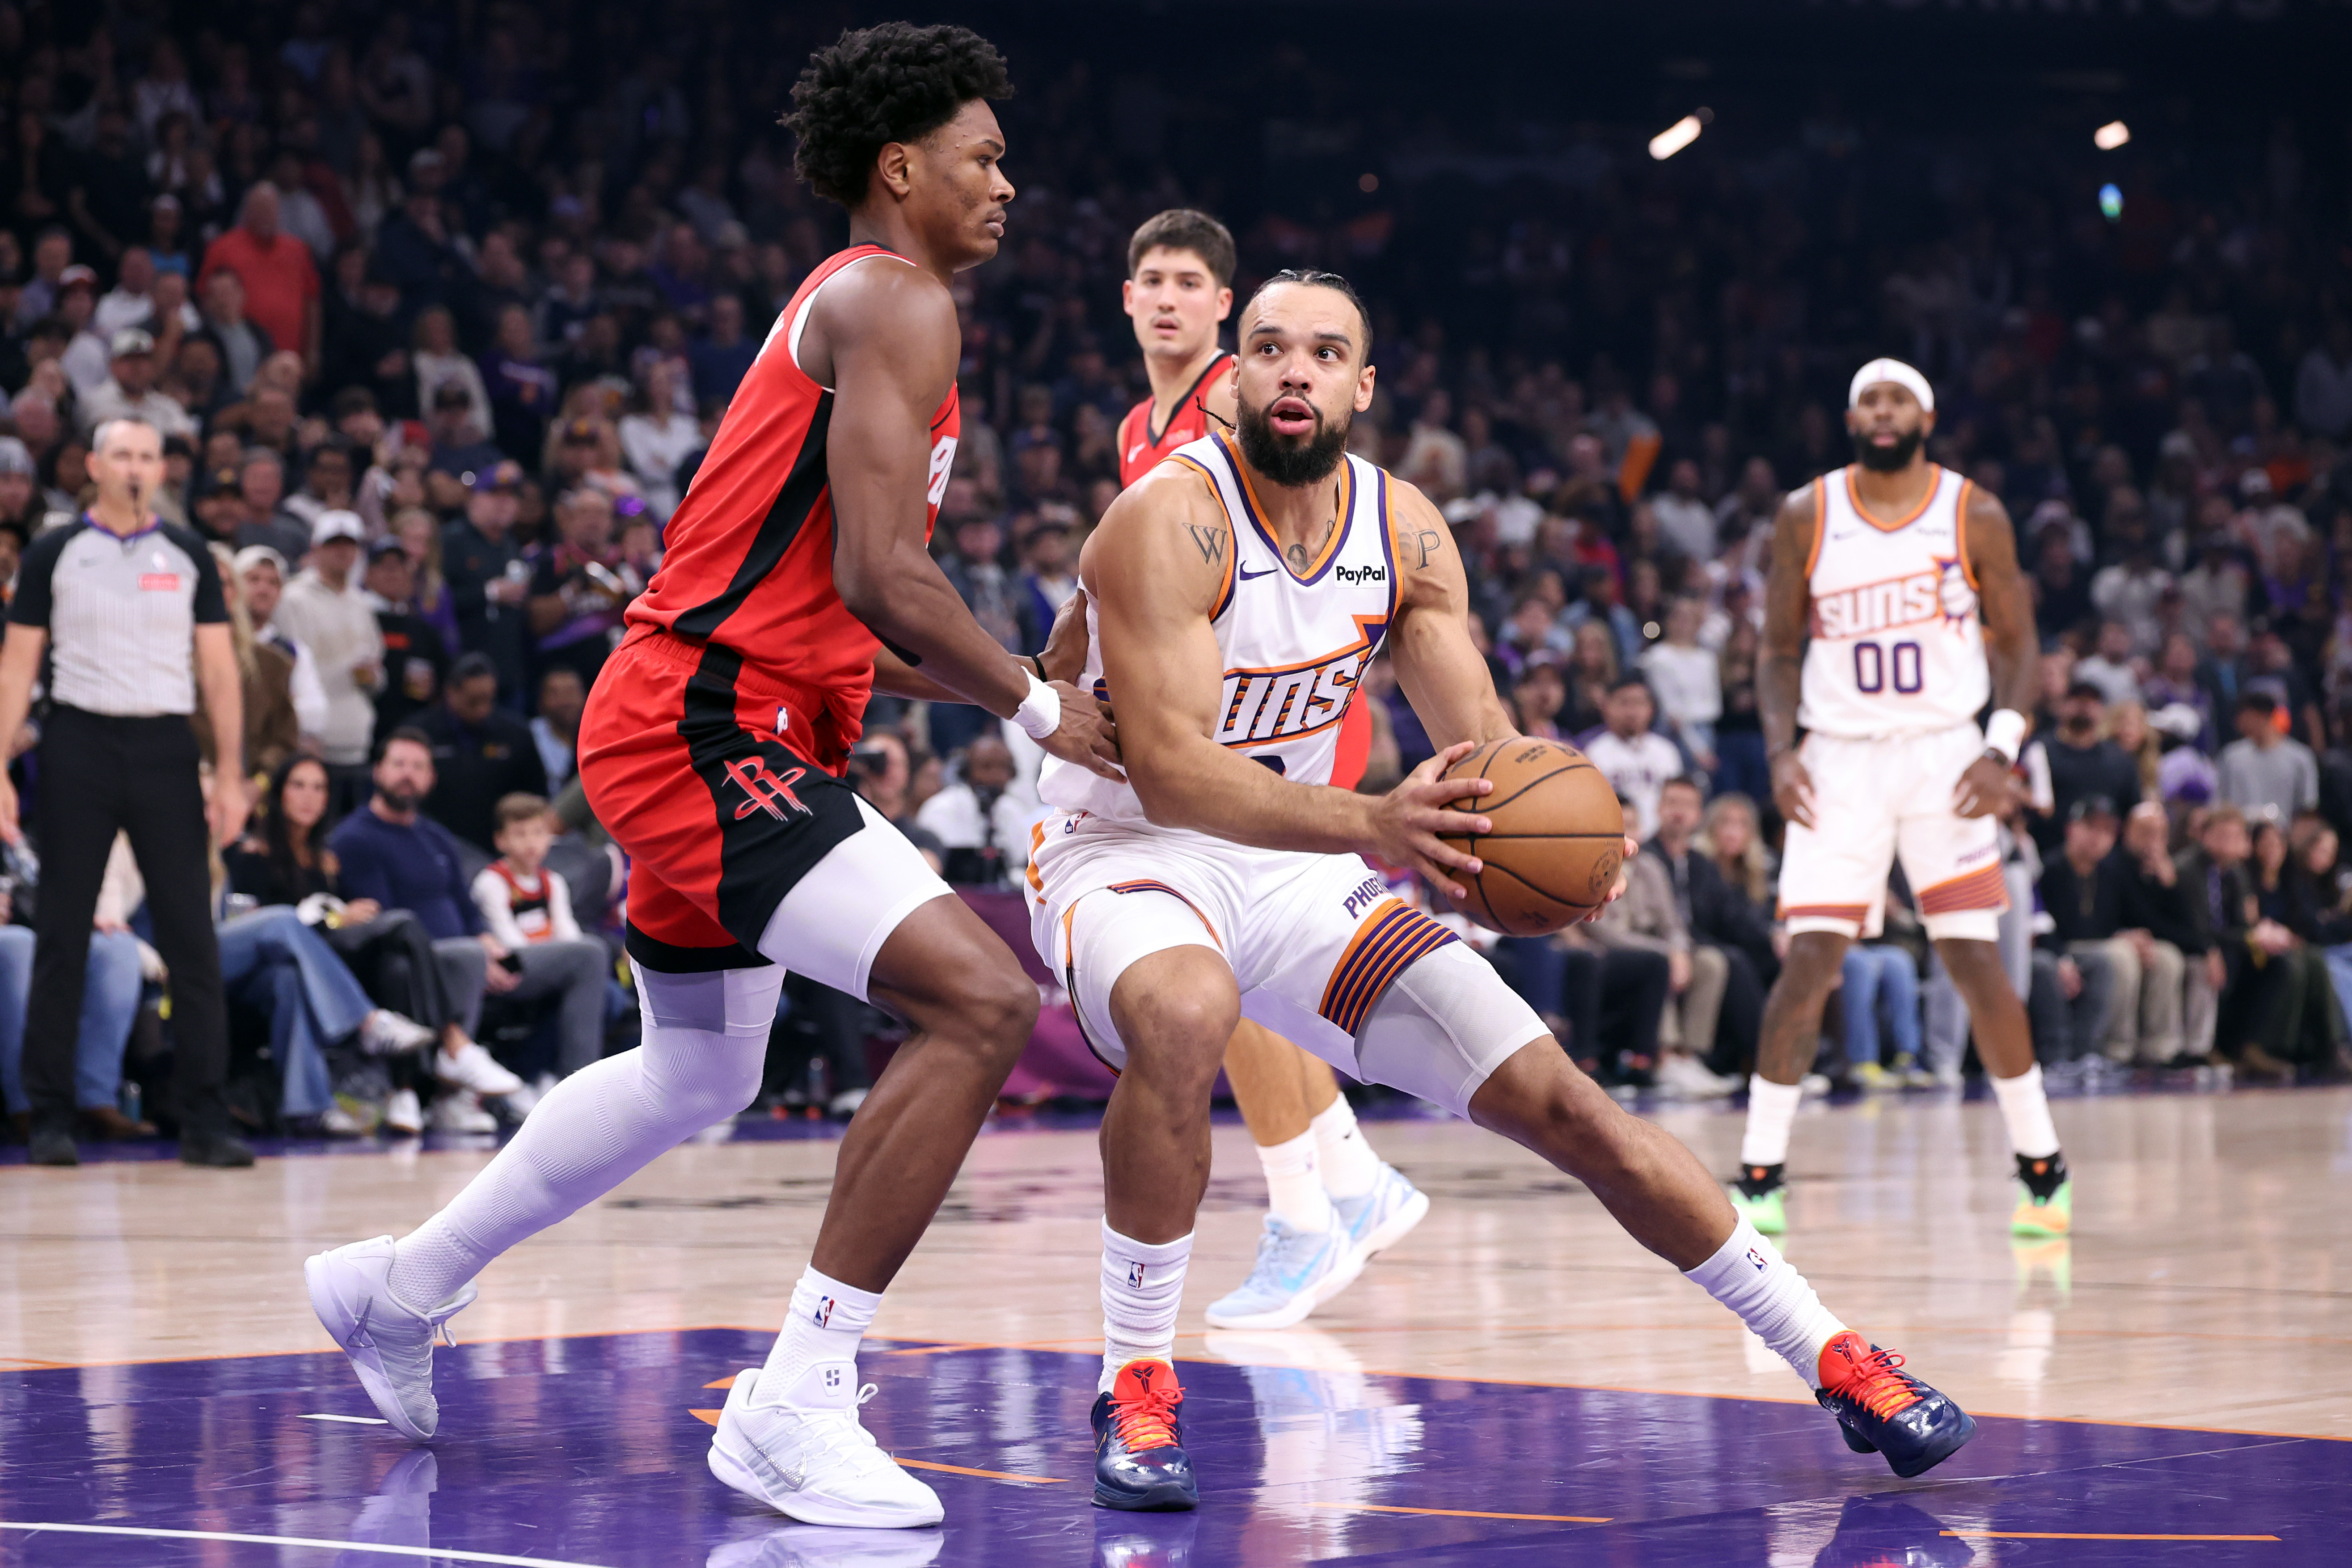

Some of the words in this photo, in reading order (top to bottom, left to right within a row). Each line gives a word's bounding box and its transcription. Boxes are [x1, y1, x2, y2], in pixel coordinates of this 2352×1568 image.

[1182, 523, 1227, 567] W
[1412, 529, 1440, 571] P
[1336, 566, 1385, 585] PayPal
[1818, 574, 1938, 637] SUNS
[1854, 642, 1922, 693] 00
[1212, 654, 1360, 743] UNS
[1128, 1279, 1137, 1287] NBA
